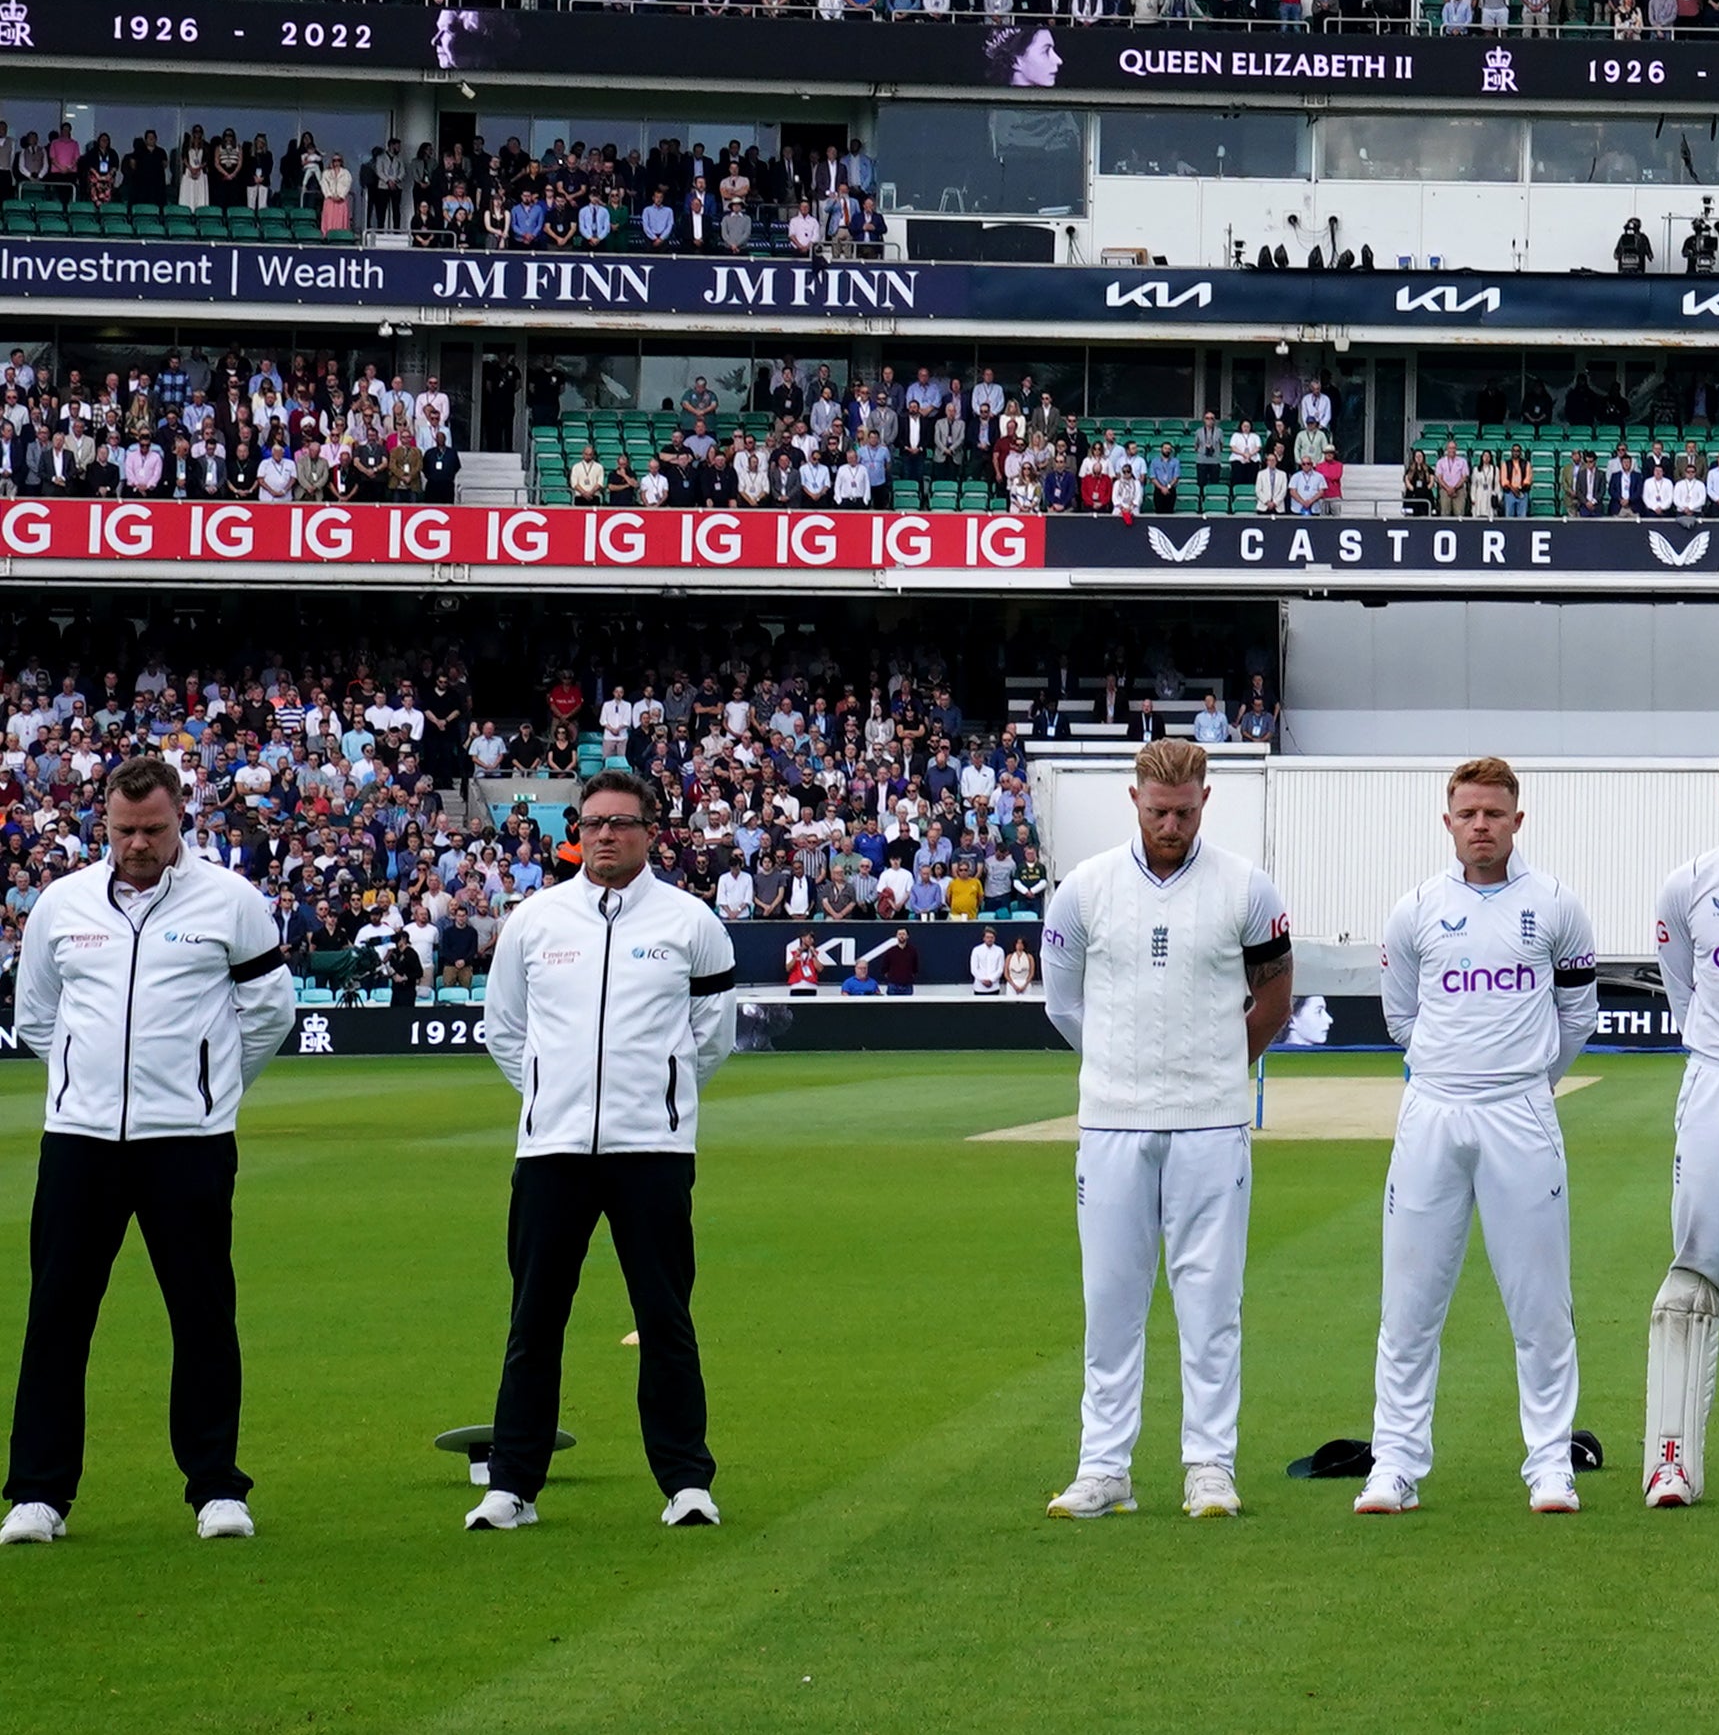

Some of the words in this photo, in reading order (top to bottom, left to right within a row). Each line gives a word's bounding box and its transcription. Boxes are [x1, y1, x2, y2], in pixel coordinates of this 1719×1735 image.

[112, 15, 200, 44] 1926
[281, 21, 371, 49] 2022
[1119, 48, 1222, 76] QUEEN
[1231, 52, 1385, 79] ELIZABETH
[1395, 55, 1413, 79] II
[1589, 59, 1665, 84] 1926
[2, 249, 212, 286] Investment
[258, 253, 384, 290] Wealth
[433, 260, 508, 299] JM
[523, 262, 654, 303] FINN
[703, 267, 777, 305] JM
[790, 269, 919, 308] FINN
[1, 502, 50, 554] G
[89, 504, 152, 555] IG
[190, 506, 253, 557] IG
[291, 508, 352, 558] IG
[389, 510, 450, 559] IG
[487, 511, 548, 561] IG
[585, 513, 645, 562] IG
[682, 514, 741, 563] IG
[777, 515, 836, 564] IG
[872, 517, 931, 565] IG
[967, 517, 1025, 566] IG
[1241, 528, 1552, 564] CASTORE
[70, 933, 109, 943] Emirates
[180, 932, 206, 944] ICC
[1654, 919, 1670, 943] G
[542, 950, 581, 959] Emirates
[647, 948, 670, 960] ICC
[1442, 957, 1536, 993] cinch
[1597, 1011, 1650, 1034] ETH
